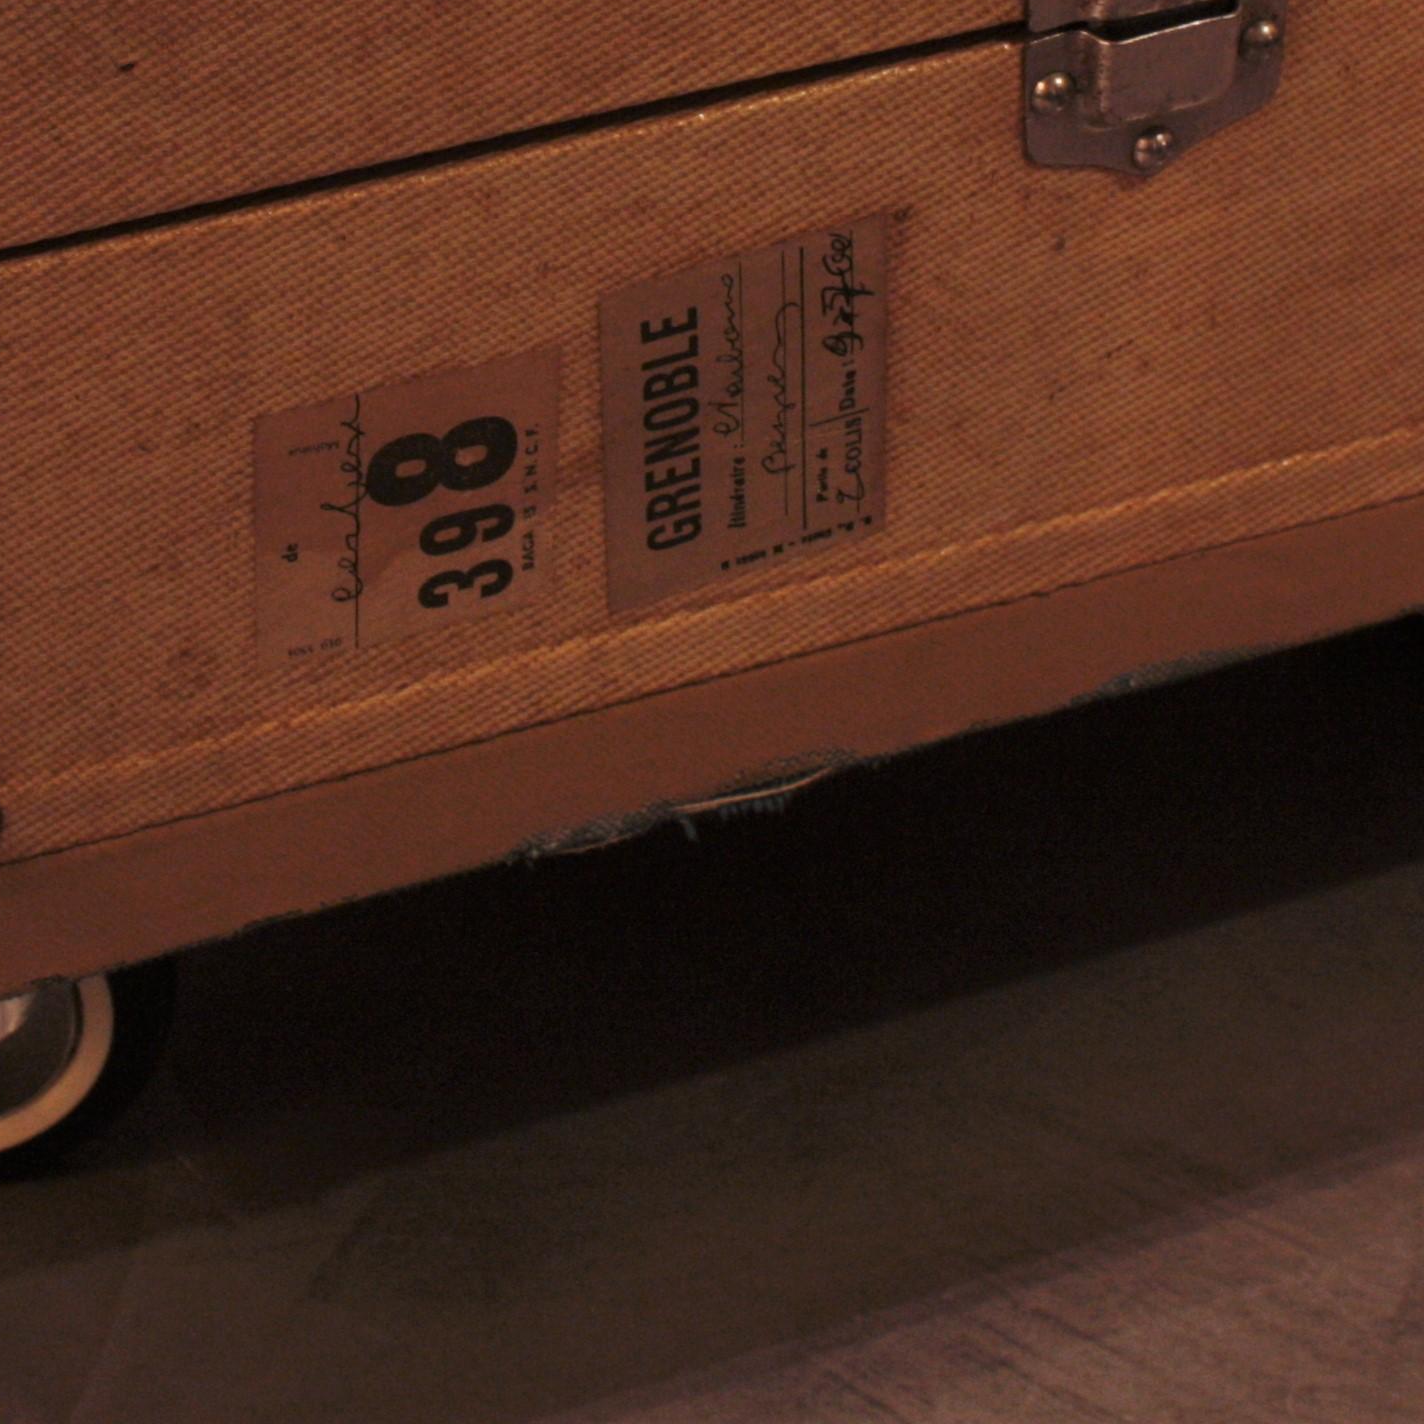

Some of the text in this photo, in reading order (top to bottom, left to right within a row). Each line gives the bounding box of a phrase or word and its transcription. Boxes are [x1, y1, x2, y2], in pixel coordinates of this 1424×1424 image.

[366, 415, 519, 609] 398
[640, 305, 703, 553] GRENOBLE
[282, 543, 299, 563] de
